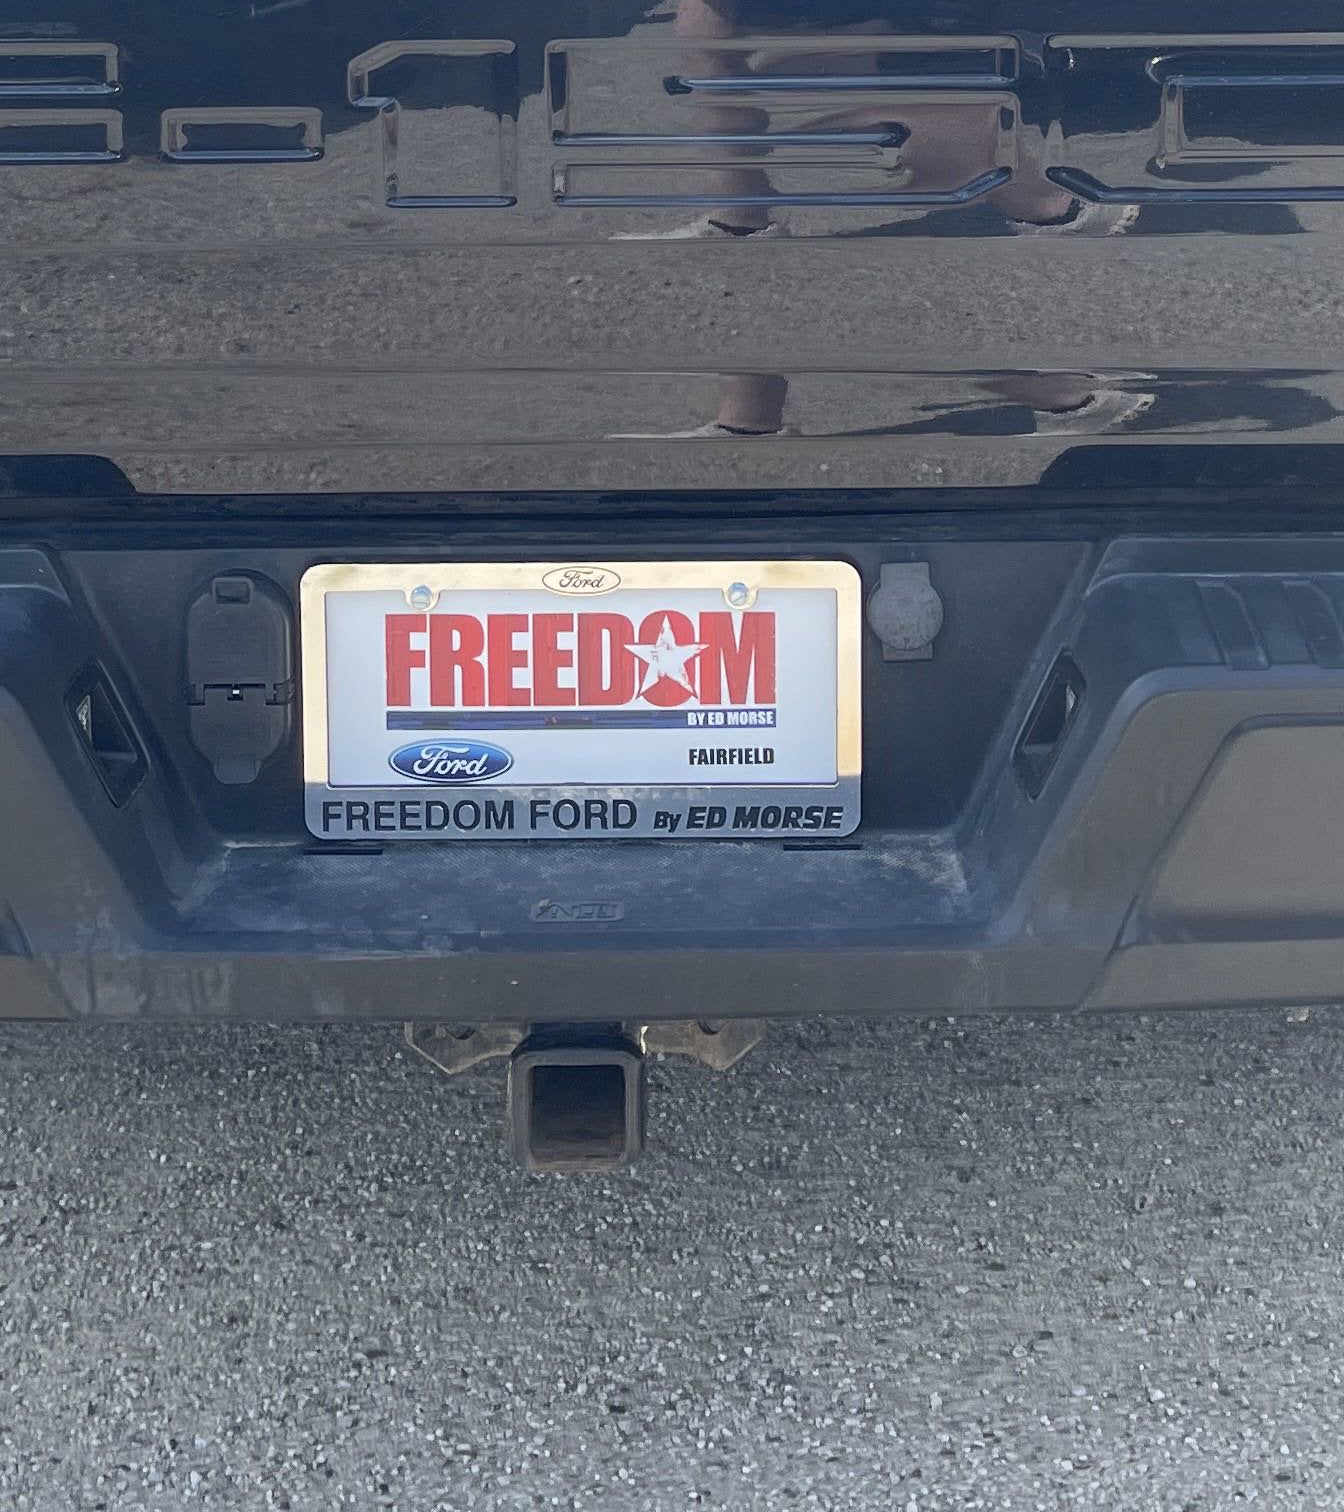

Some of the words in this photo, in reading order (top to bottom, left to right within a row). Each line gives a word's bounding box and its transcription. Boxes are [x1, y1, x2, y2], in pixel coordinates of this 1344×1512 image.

[559, 569, 606, 589] Ford
[385, 610, 776, 707] FREEDOM
[687, 712, 705, 726] BY
[707, 712, 724, 726] ED
[727, 711, 774, 726] MORSE
[413, 744, 490, 775] Ford
[688, 748, 774, 765] FAIRFIELD
[321, 799, 516, 832] FREEDOM
[529, 799, 638, 831] FORD
[654, 811, 682, 833] By
[686, 806, 727, 830] ED
[732, 805, 844, 830] MORSE
